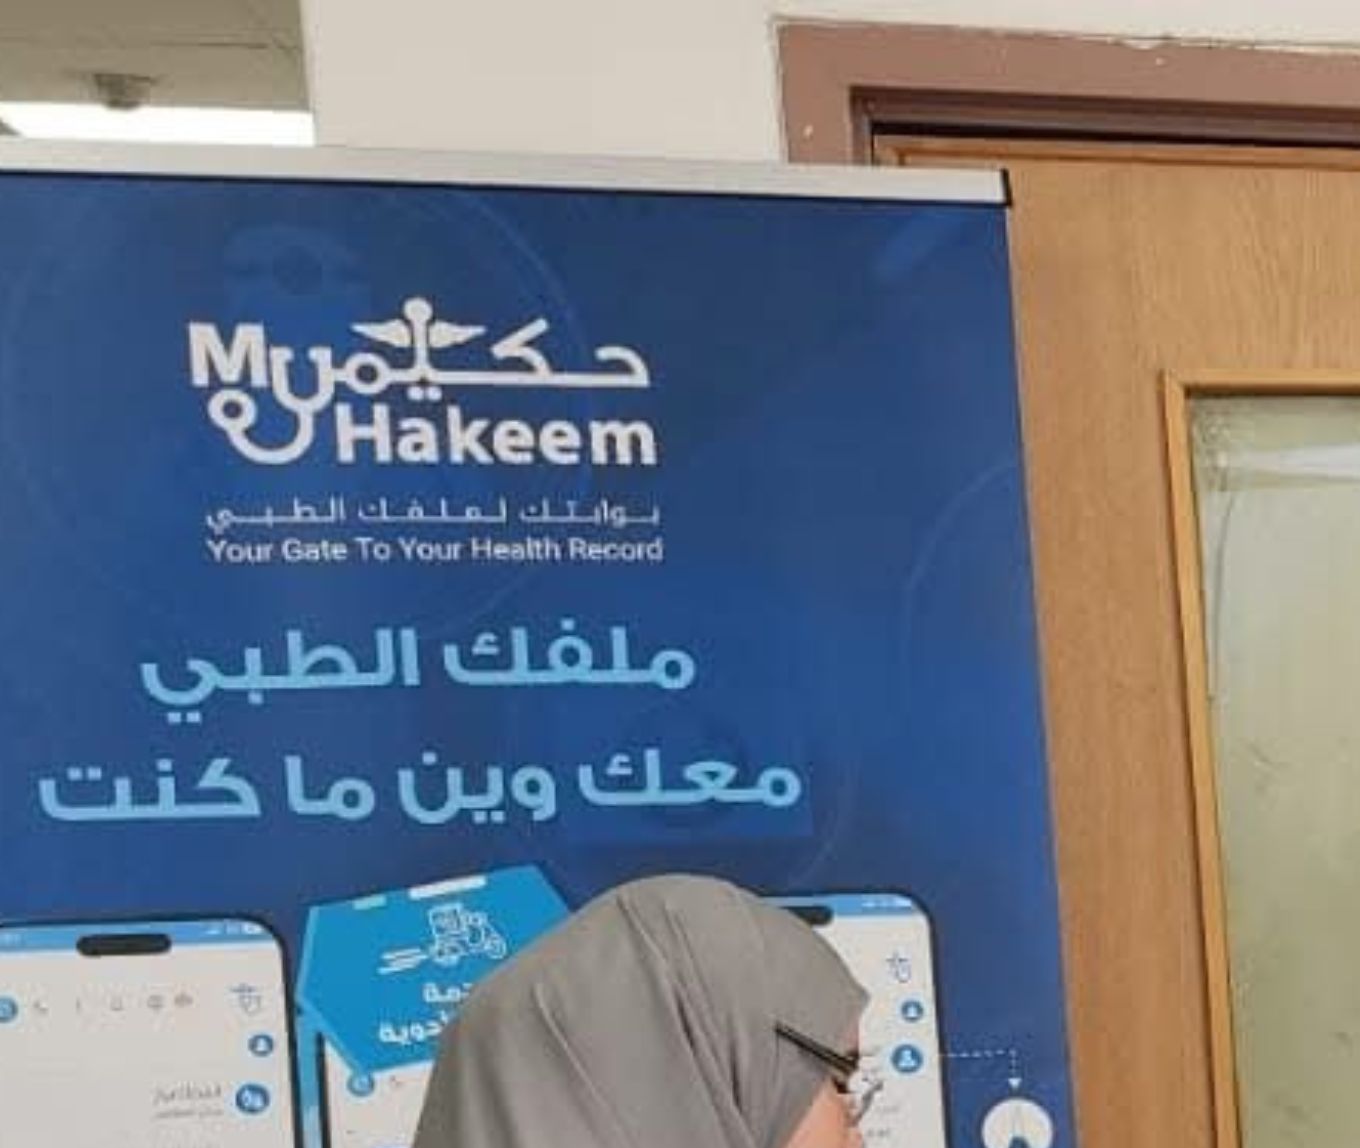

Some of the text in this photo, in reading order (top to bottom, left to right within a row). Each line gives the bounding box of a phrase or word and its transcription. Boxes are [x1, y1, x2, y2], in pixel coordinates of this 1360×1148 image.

[335, 402, 658, 465] Hakeem
[206, 497, 346, 535] الطبي
[357, 498, 508, 523] لملفك
[207, 536, 664, 563] Your Gate To Your Health Record
[139, 618, 697, 723] ملفك الطبي
[38, 747, 802, 824] معك وين ما كنت
